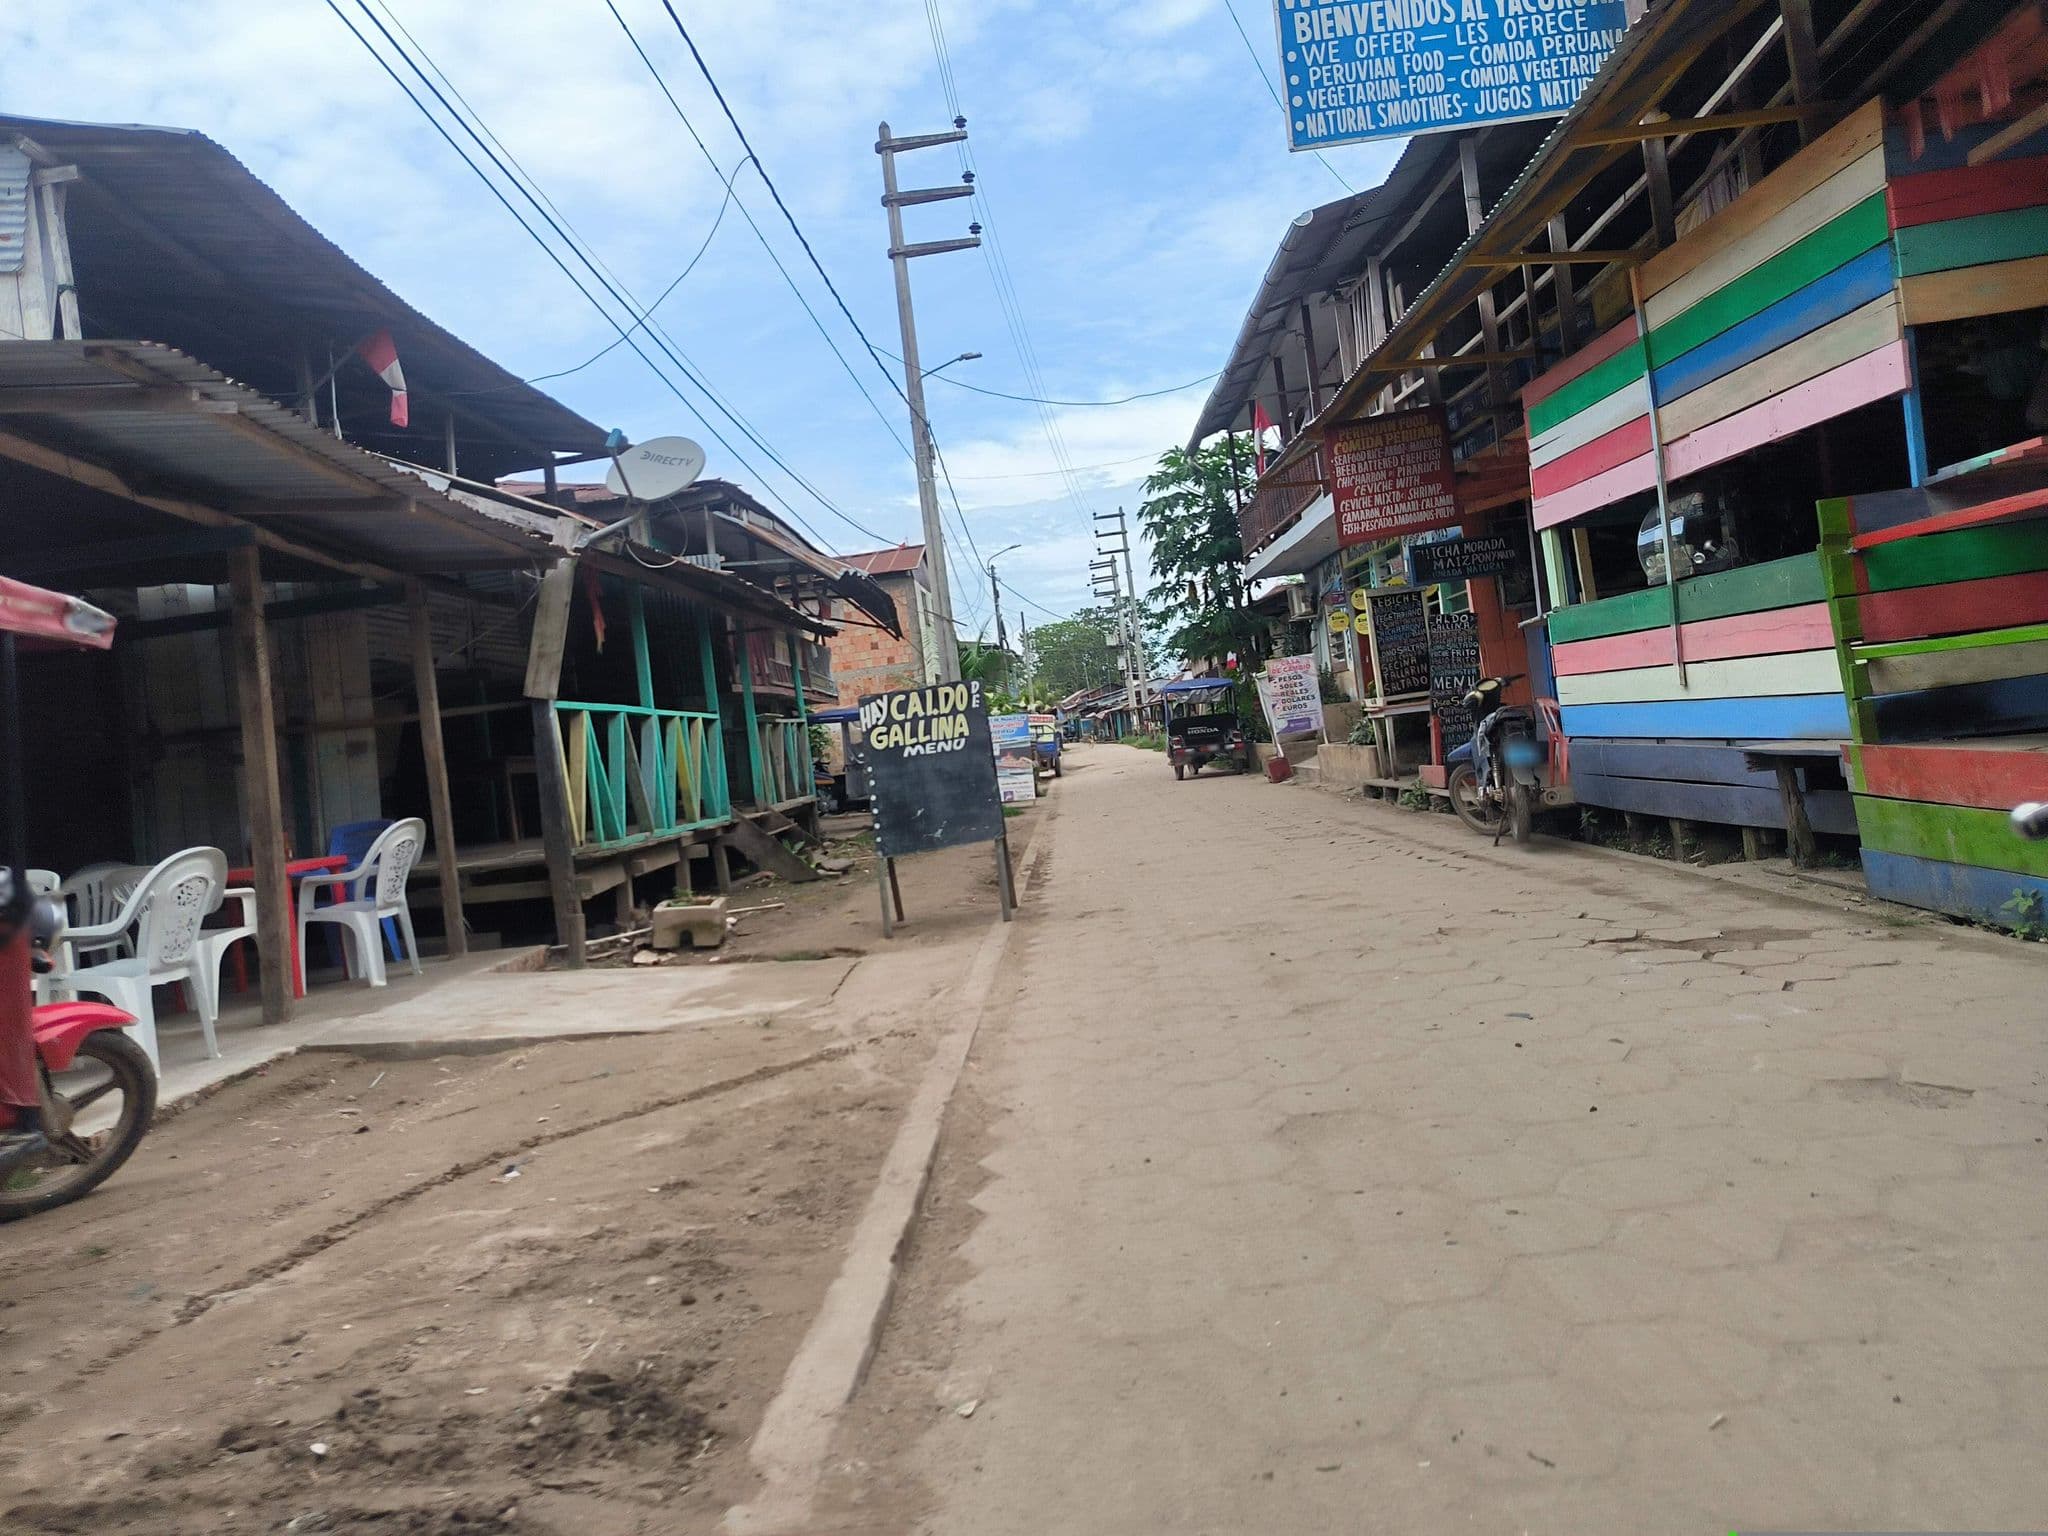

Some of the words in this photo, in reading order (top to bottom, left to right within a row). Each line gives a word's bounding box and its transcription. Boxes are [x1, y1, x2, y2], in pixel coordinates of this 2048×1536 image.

[1294, 0, 1457, 43] BIENVENIDOS
[1302, 40, 1340, 66] WE
[1355, 30, 1416, 58] OFFER
[1455, 22, 1488, 46] LES
[1504, 9, 1588, 40] OFRECE
[1309, 56, 1396, 88] PERUVIAN
[1403, 49, 1444, 75] FOOD
[1469, 39, 1536, 65] COMIDA
[1461, 64, 1519, 88] COMIDA
[1305, 105, 1375, 138] NATURAL
[1474, 85, 1531, 114] JUGOS
[640, 450, 694, 466] DIRECTV
[1333, 435, 1384, 456] COMIDA
[1336, 464, 1357, 477] BEER
[1357, 455, 1398, 473] BATTERED
[1354, 480, 1393, 496] CEVICHE
[1340, 495, 1373, 512] CEVICHE
[859, 694, 889, 732] HAY
[889, 683, 968, 720] CALDO
[869, 714, 970, 750] GALLINA
